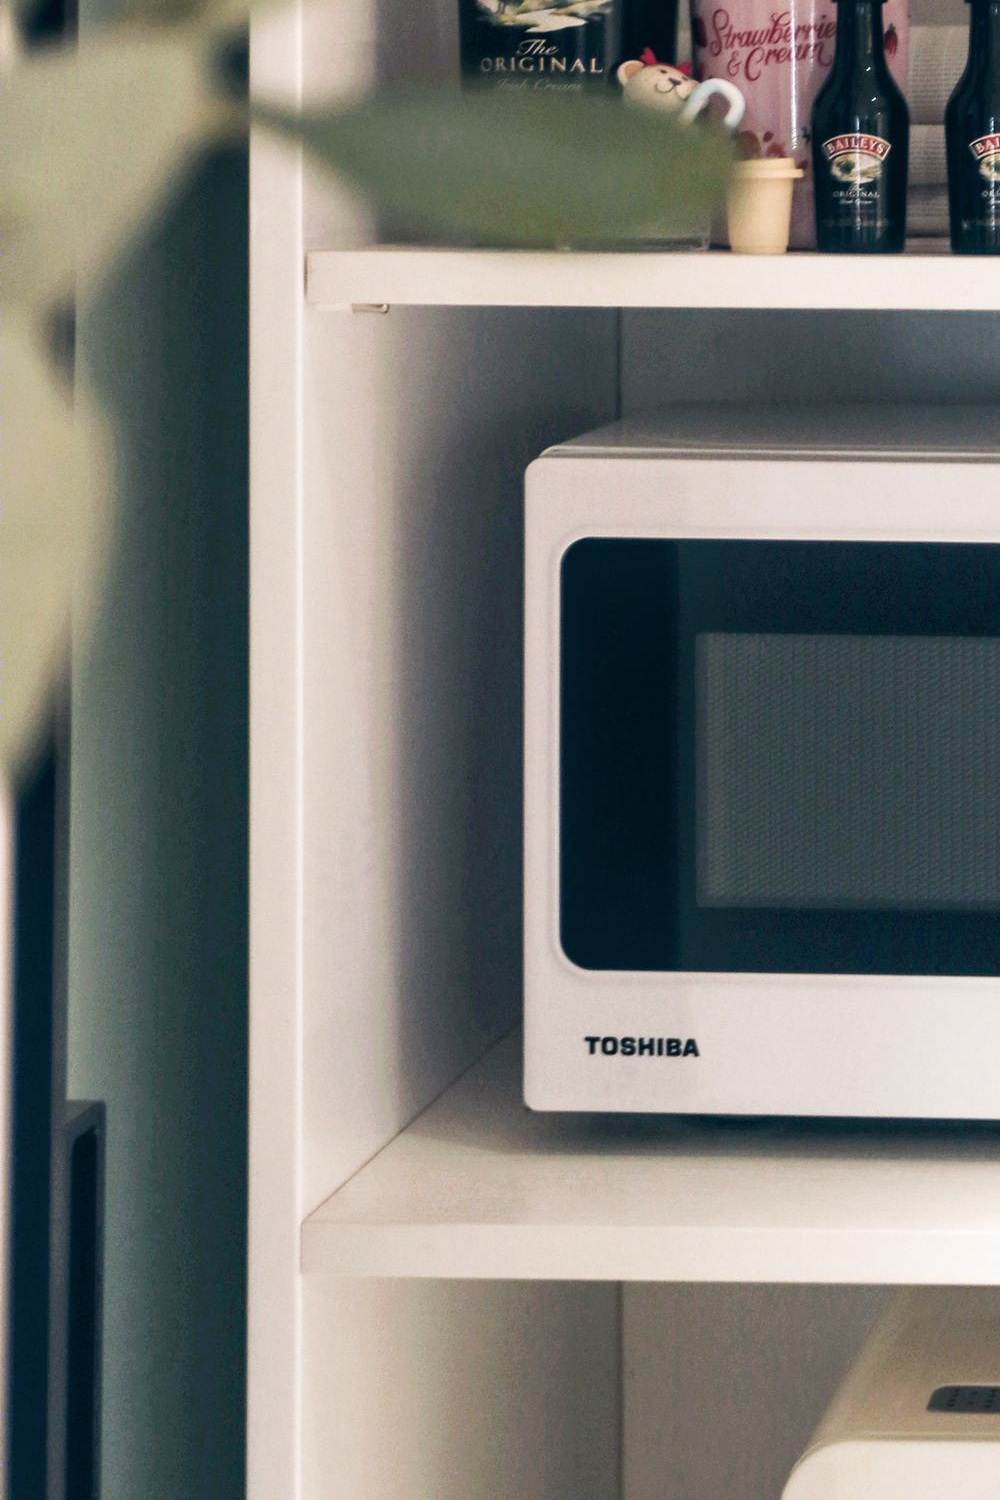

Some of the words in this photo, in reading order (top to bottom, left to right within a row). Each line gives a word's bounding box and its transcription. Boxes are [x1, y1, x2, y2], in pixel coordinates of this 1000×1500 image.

[710, 8, 837, 57] Strawberrie
[516, 39, 559, 56] The
[480, 57, 604, 74] ORIGINAL
[745, 37, 833, 82] Cream
[828, 136, 885, 154] BAILEYS
[584, 1036, 700, 1057] TOSHIBA
